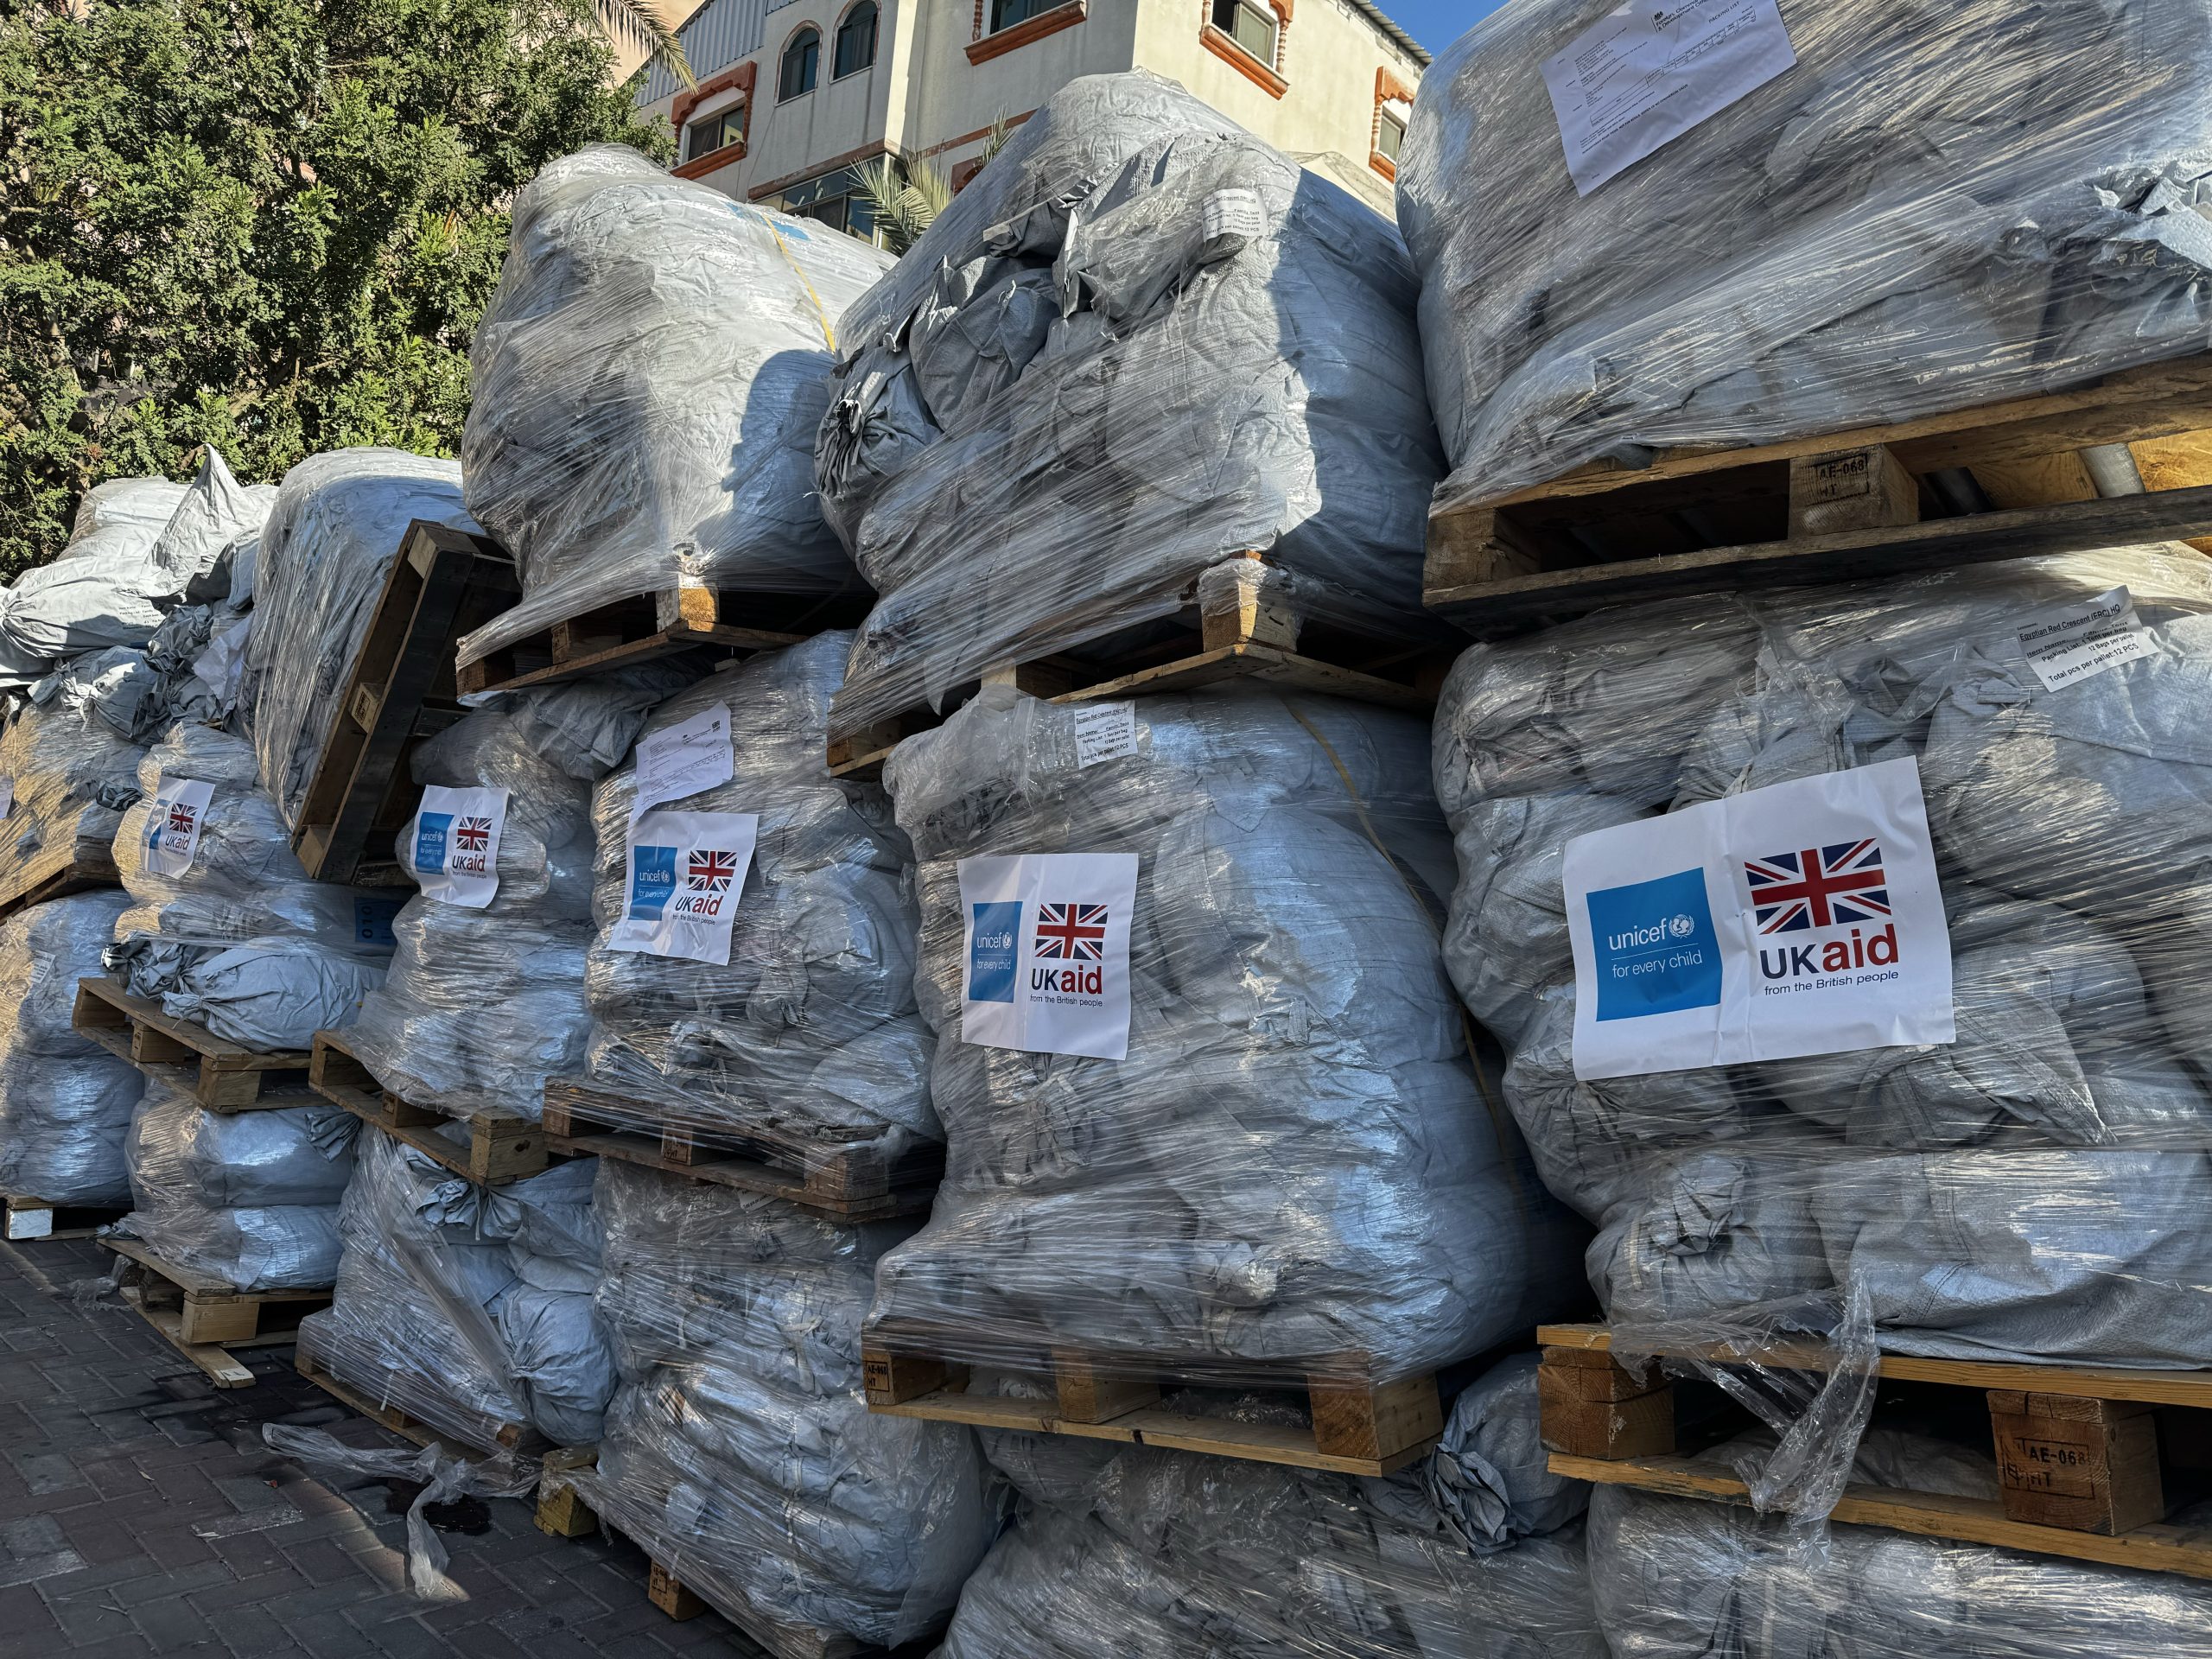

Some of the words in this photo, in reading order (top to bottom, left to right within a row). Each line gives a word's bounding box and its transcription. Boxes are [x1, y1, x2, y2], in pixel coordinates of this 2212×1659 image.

[2019, 627, 2048, 641] Egyptian
[2049, 623, 2061, 633] Red
[2062, 615, 2091, 629] Crescent
[2111, 603, 2120, 613] HQ
[2096, 641, 2110, 650] Bags
[2120, 632, 2134, 642] pallet
[2042, 649, 2068, 663] Packing
[2068, 642, 2082, 653] List:
[2048, 671, 2067, 683] Total
[2068, 666, 2081, 676] pcs
[2081, 661, 2093, 671] per
[2123, 642, 2139, 653] PCS
[422, 830, 437, 841] unicef
[452, 854, 486, 872] UKaid
[639, 869, 660, 881] unicef
[675, 894, 724, 916] UKaid
[976, 932, 1002, 949] unicef
[1608, 917, 1667, 950] unicef
[1760, 923, 1899, 979] UKaid
[983, 961, 998, 970] every
[998, 959, 1011, 970] child
[1612, 964, 1630, 979] for
[1632, 960, 1666, 976] every
[1669, 951, 1702, 968] child
[1031, 964, 1103, 995] UKaid
[1764, 982, 1790, 995] from
[1794, 981, 1812, 993] the
[1816, 976, 1853, 989] British
[1856, 969, 1899, 986] people
[1045, 995, 1055, 1003] the
[1057, 995, 1077, 1005] British
[1079, 999, 1103, 1007] people
